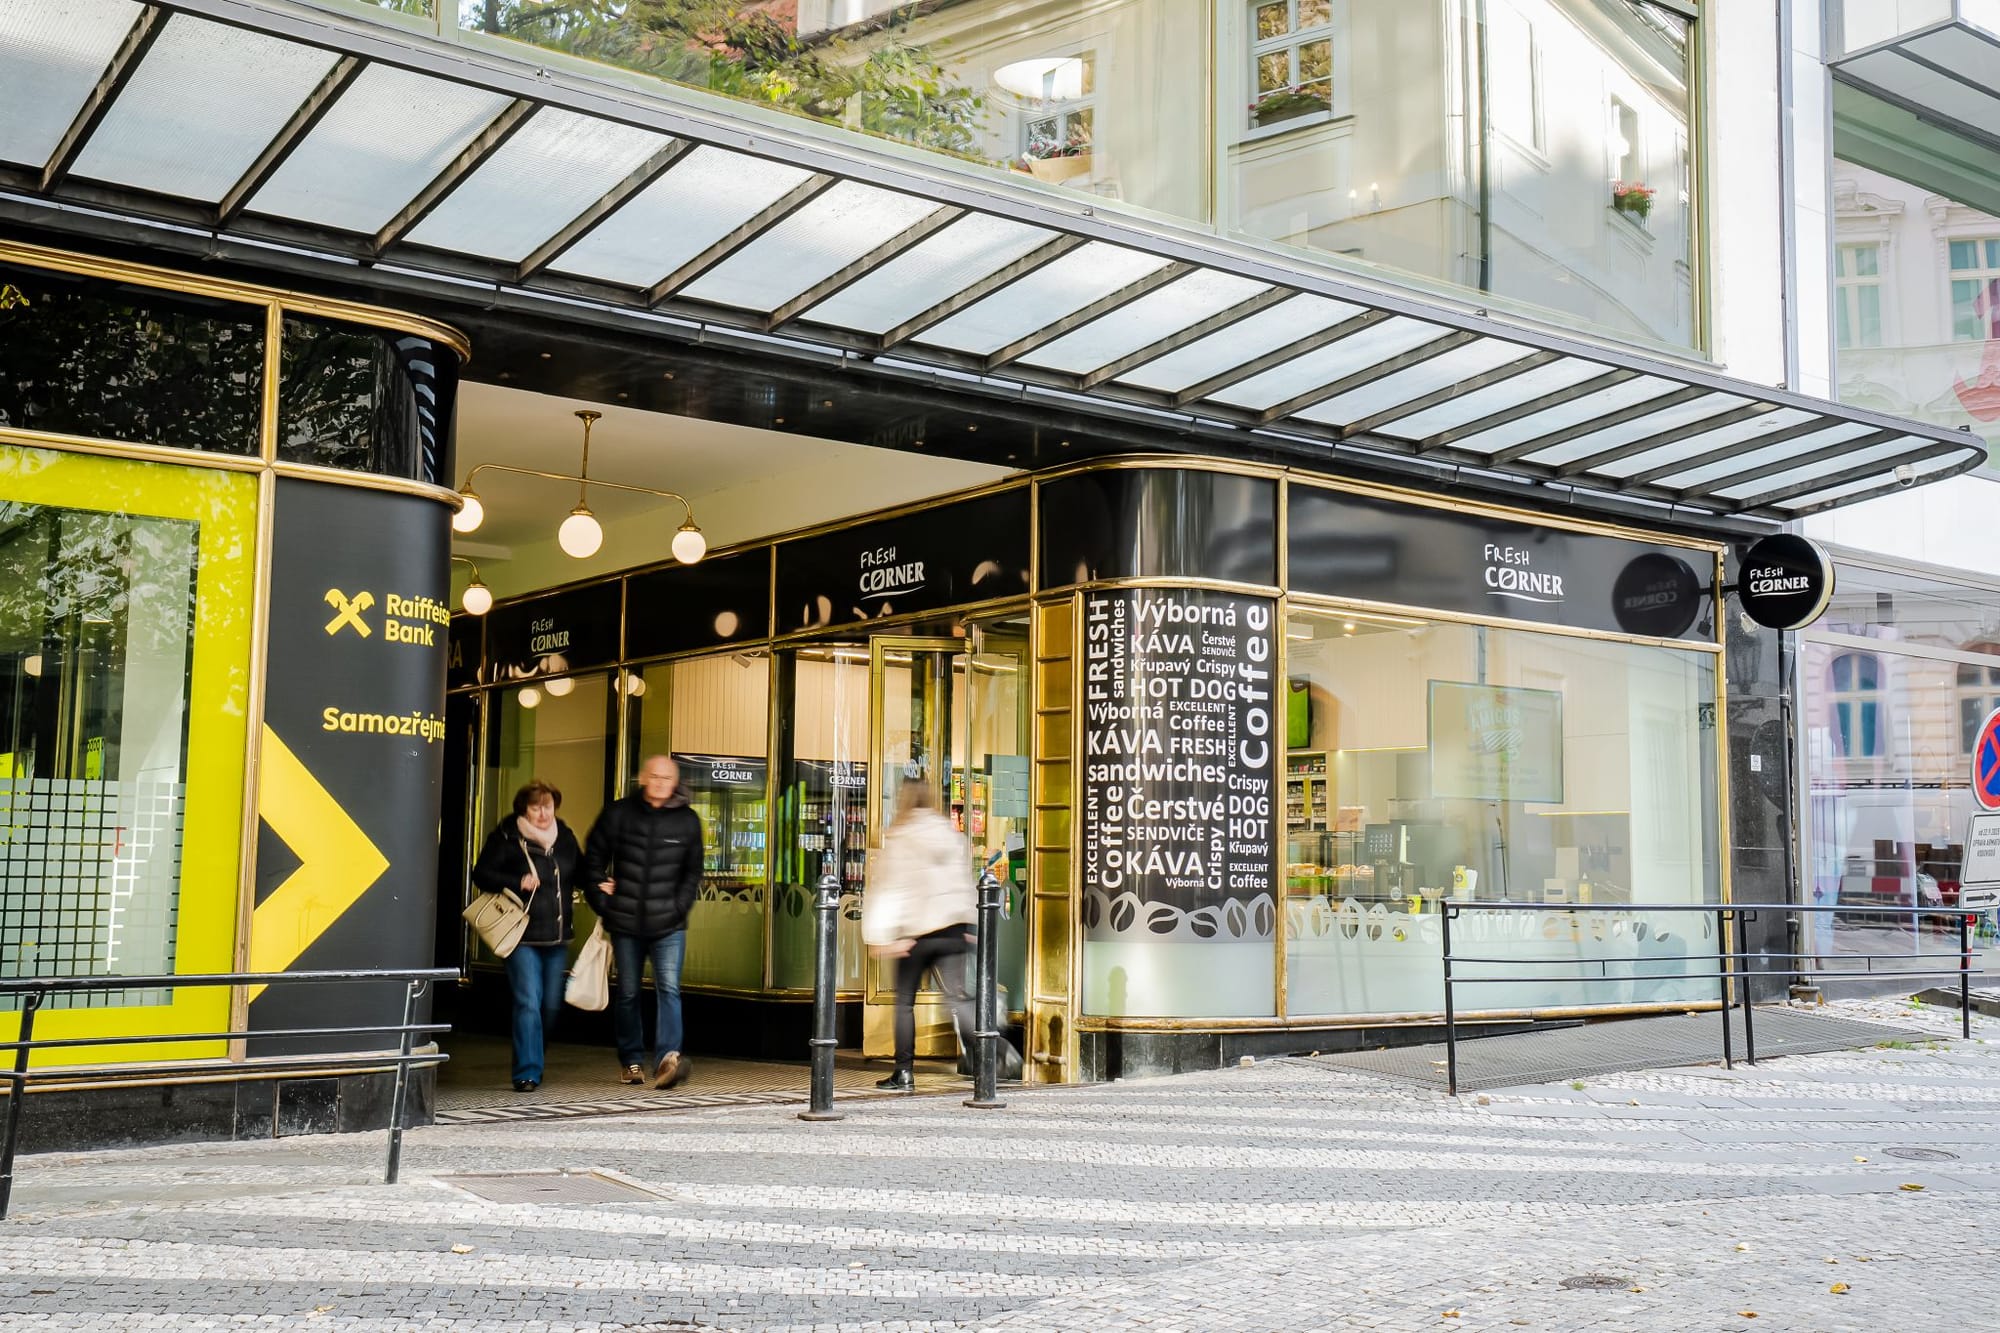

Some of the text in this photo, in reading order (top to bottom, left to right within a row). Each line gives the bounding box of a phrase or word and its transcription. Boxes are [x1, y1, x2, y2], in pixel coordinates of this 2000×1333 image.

[860, 546, 896, 568] FRESH
[1484, 544, 1530, 566] FRESH
[860, 562, 925, 592] CORNER
[1485, 566, 1564, 596] CORNER
[1750, 567, 1783, 580] FRESH
[1750, 576, 1809, 592] CORNER
[1131, 598, 1236, 628] Výborná
[385, 620, 434, 646] Bank
[532, 618, 554, 634] FRESH
[531, 630, 570, 652] CORNER
[1089, 600, 1108, 699] FRESH
[1110, 599, 1124, 698] sandwiches
[1130, 629, 1194, 654] KÁVA
[1202, 631, 1236, 646] Čerstvé
[1202, 646, 1236, 658] SENDVIČE
[1131, 658, 1236, 678] Křupavý Crispy
[1130, 678, 1236, 701] HOT DOG
[1238, 605, 1268, 768] Coffee
[1089, 702, 1164, 724] Výborná
[1170, 701, 1226, 713] EXCELLENT
[1170, 715, 1225, 732] Coffee
[1088, 724, 1163, 755] KÁVA
[1170, 738, 1226, 756] FRESH
[1228, 704, 1236, 768] EXCELLENT
[712, 770, 752, 780] CORNER
[1088, 758, 1226, 783] sandwiches
[1228, 774, 1268, 794] Crispy
[1127, 787, 1224, 821] Čerstvé
[1229, 796, 1269, 816] DOG
[1088, 786, 1098, 884] EXCELLENT
[1101, 786, 1122, 888] Coffee
[1127, 824, 1204, 841] SENDVIČE
[1229, 818, 1268, 839] HOT
[1208, 827, 1225, 889] Crispy
[1229, 841, 1268, 856] Křupavý
[1126, 845, 1204, 876] KÁVA
[1229, 863, 1268, 872] EXCELLENT
[1166, 877, 1204, 888] Výborná
[1229, 874, 1268, 888] Coffee
